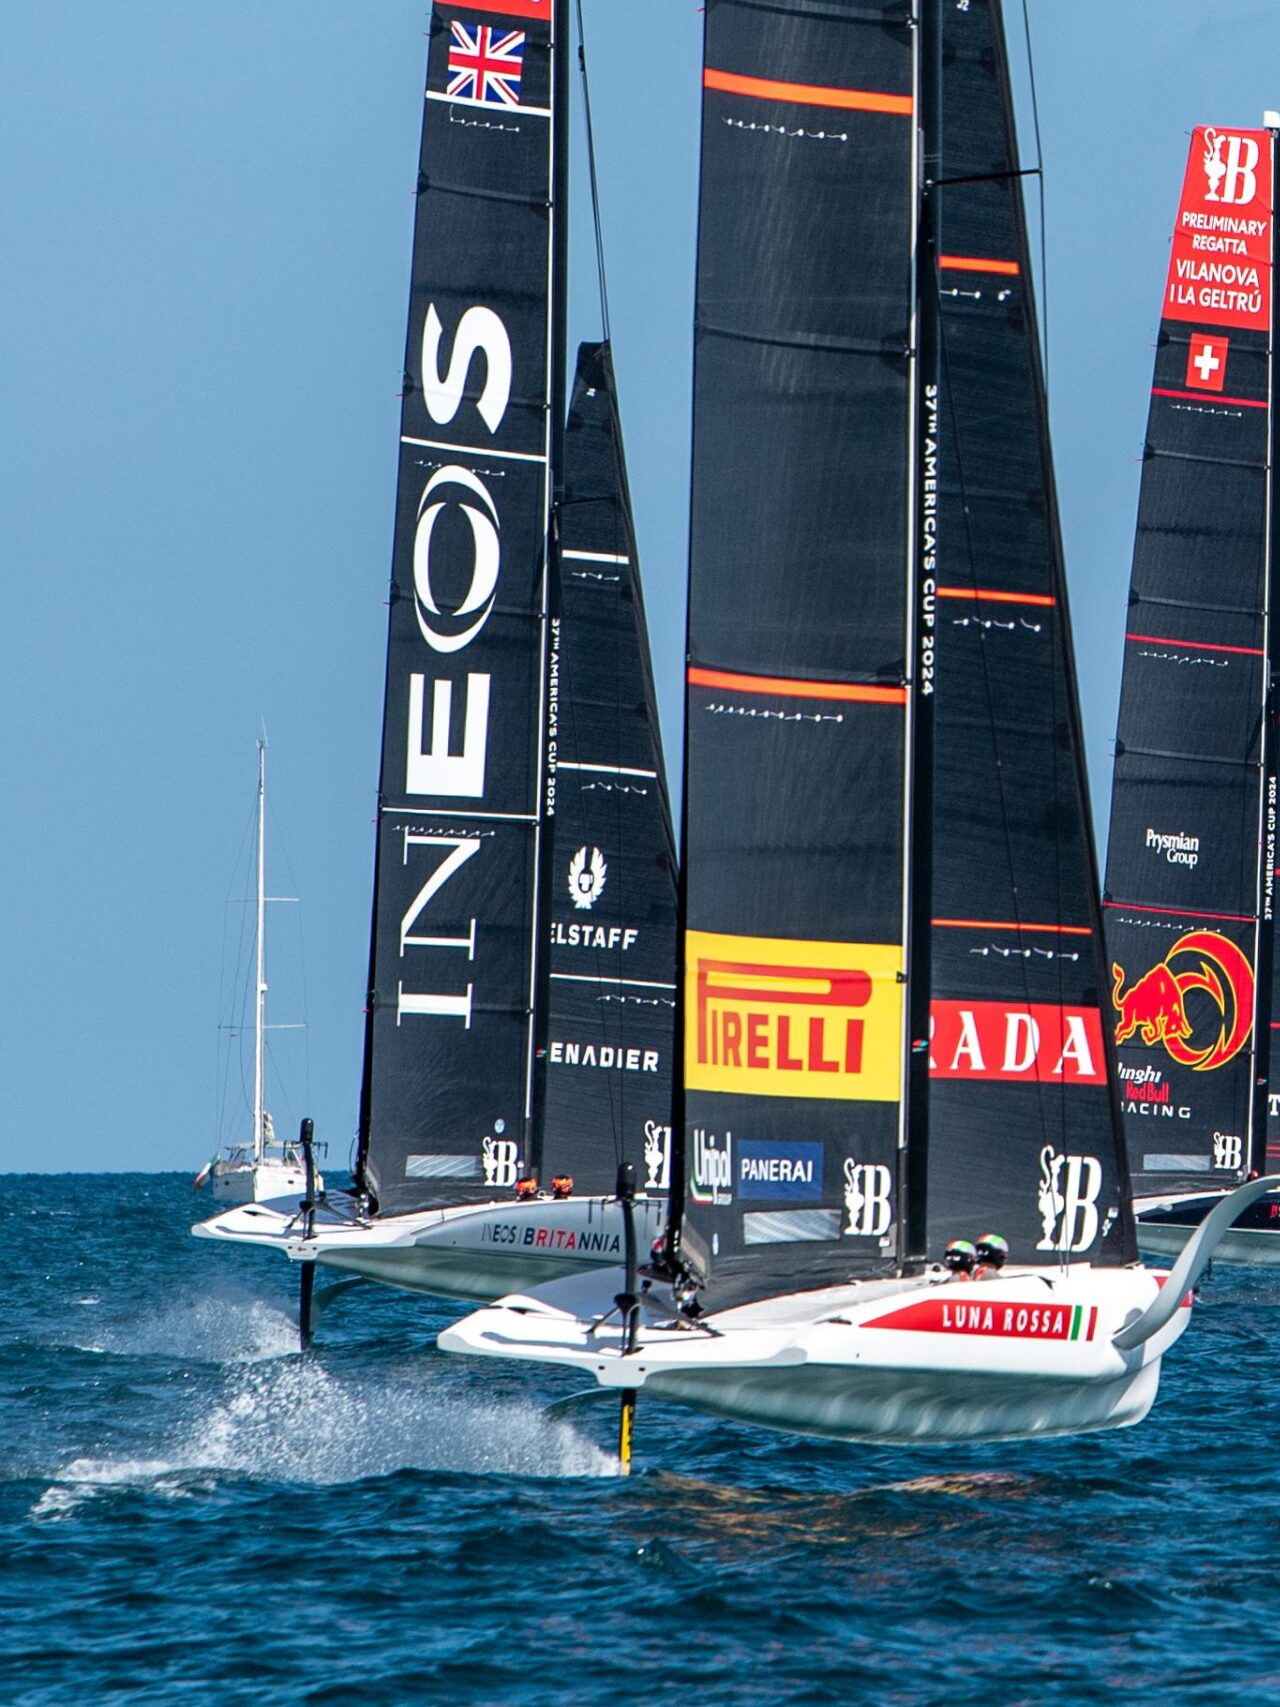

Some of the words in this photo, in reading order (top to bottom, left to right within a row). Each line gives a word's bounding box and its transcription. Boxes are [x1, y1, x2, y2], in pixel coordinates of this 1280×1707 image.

[1182, 211, 1267, 236] PRELIMINARY
[1192, 234, 1248, 255] REGATTA
[1176, 259, 1260, 288] VILANOVA
[1170, 284, 1176, 302] I
[1177, 285, 1195, 306] LA
[1199, 289, 1262, 313] GELTRÚ
[924, 384, 938, 434] 37TH
[923, 438, 937, 571] AMERICA'S
[922, 579, 936, 627] CUP
[397, 302, 513, 1029] INEOS
[921, 635, 935, 696] 2024
[549, 652, 560, 736] AMERICA'S
[548, 741, 558, 773] CUP
[546, 778, 556, 816] 2024
[1268, 776, 1277, 804] 2024
[1267, 808, 1276, 831] CUP
[1146, 829, 1199, 854] Prysmian
[1166, 848, 1198, 869] Group
[1265, 833, 1276, 896] AMERICA'S
[697, 958, 872, 1074] PIRELLI
[550, 1042, 659, 1072] ENADIER
[741, 1158, 813, 1182] PANERAI
[481, 1222, 517, 1245] INEOS
[523, 1226, 621, 1253] BRITANNIA
[942, 1304, 993, 1330] LUNA
[1003, 1308, 1063, 1334] ROSSA
